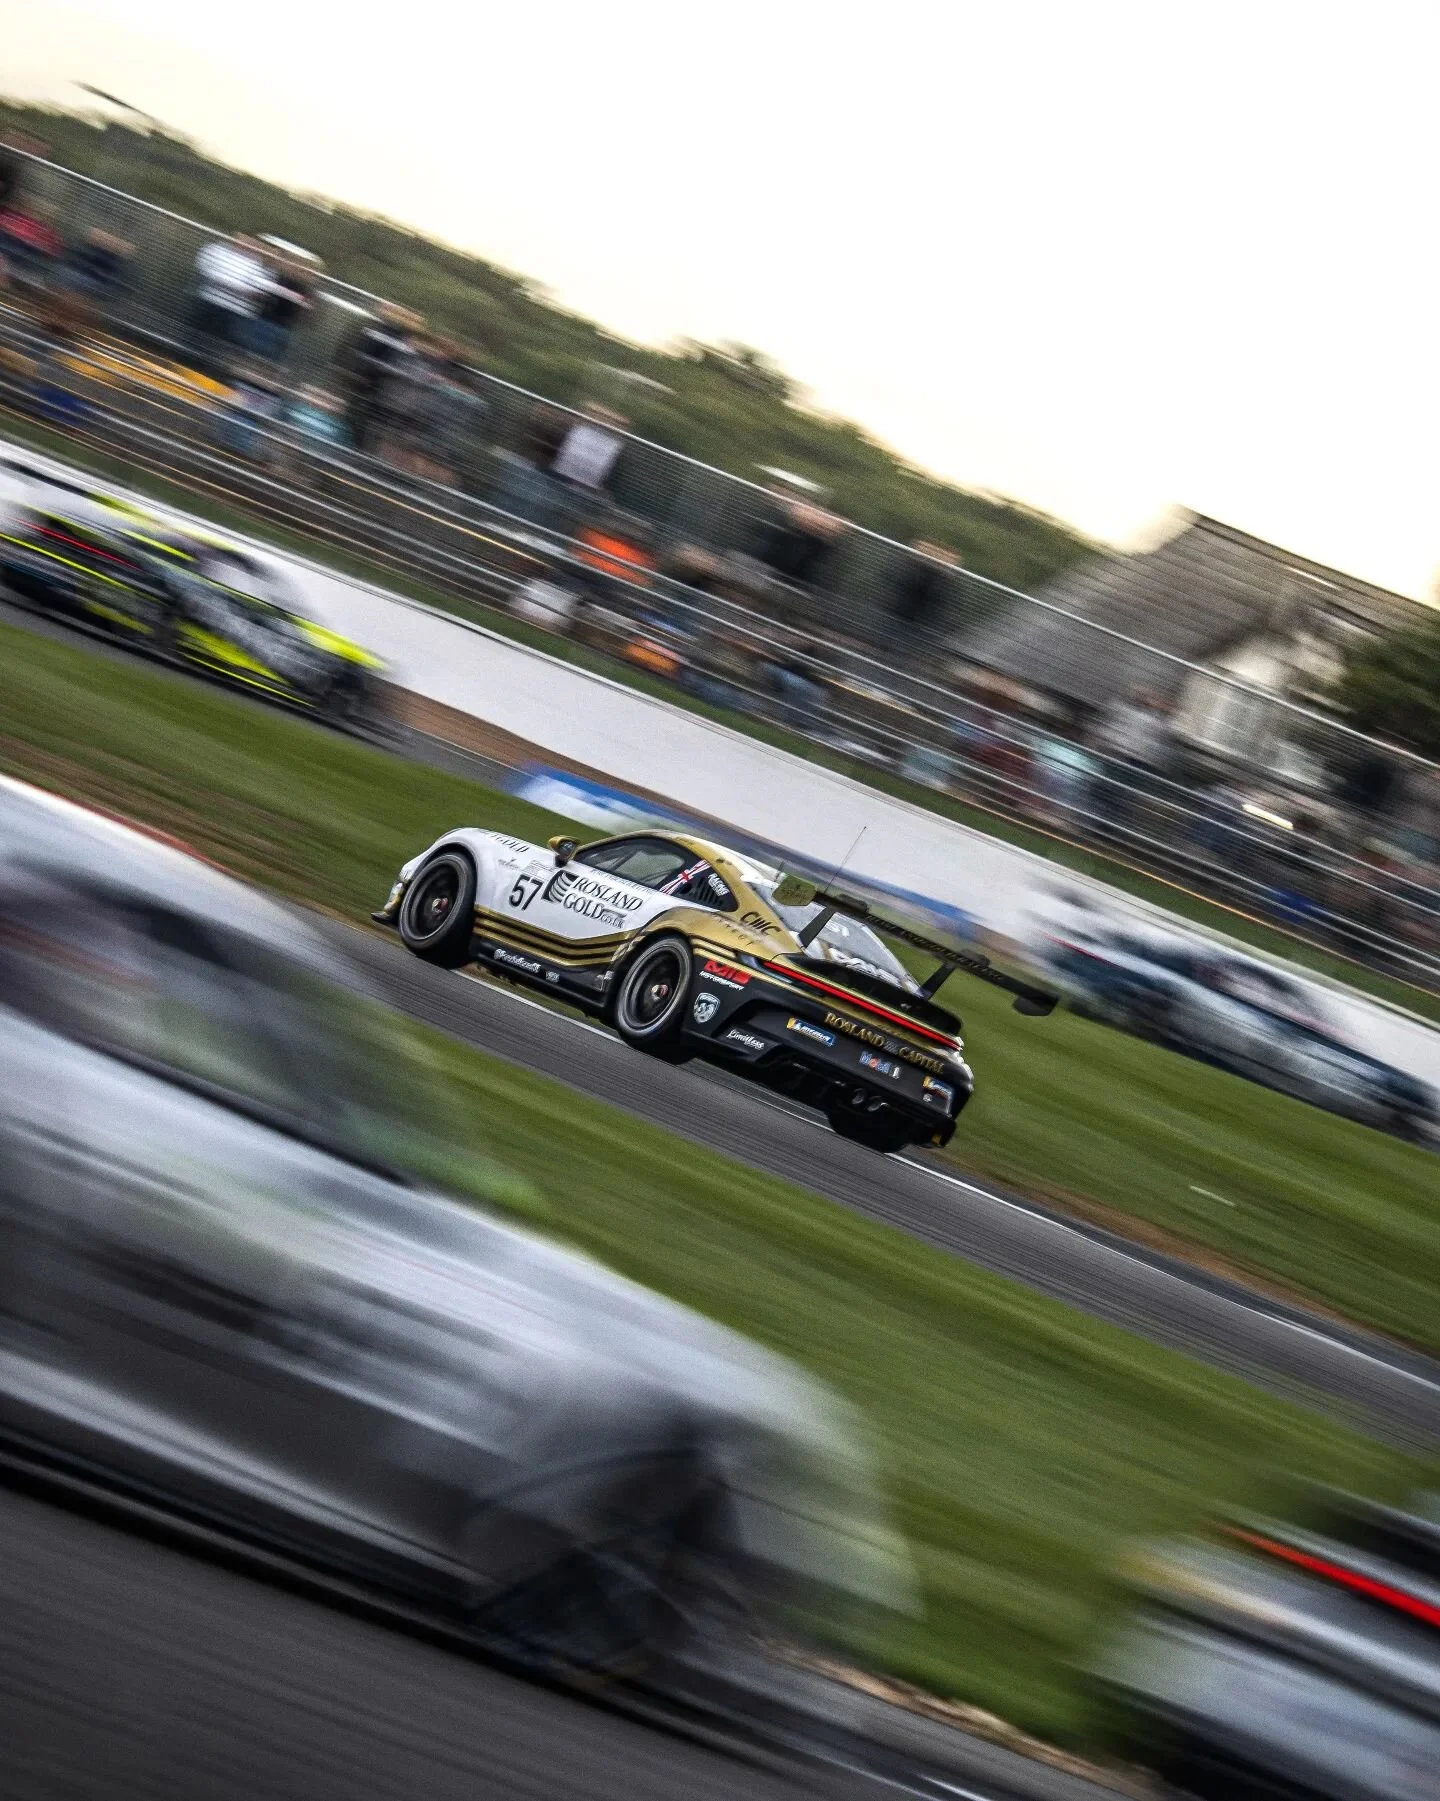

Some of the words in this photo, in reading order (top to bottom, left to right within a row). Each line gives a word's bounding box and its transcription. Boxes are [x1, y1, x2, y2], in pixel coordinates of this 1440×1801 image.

[508, 874, 544, 911] 57
[563, 893, 604, 920] GOLD
[572, 875, 643, 911] ROSLAND
[823, 1012, 885, 1048] ROSLAND
[899, 1046, 945, 1075] CAPITAL
